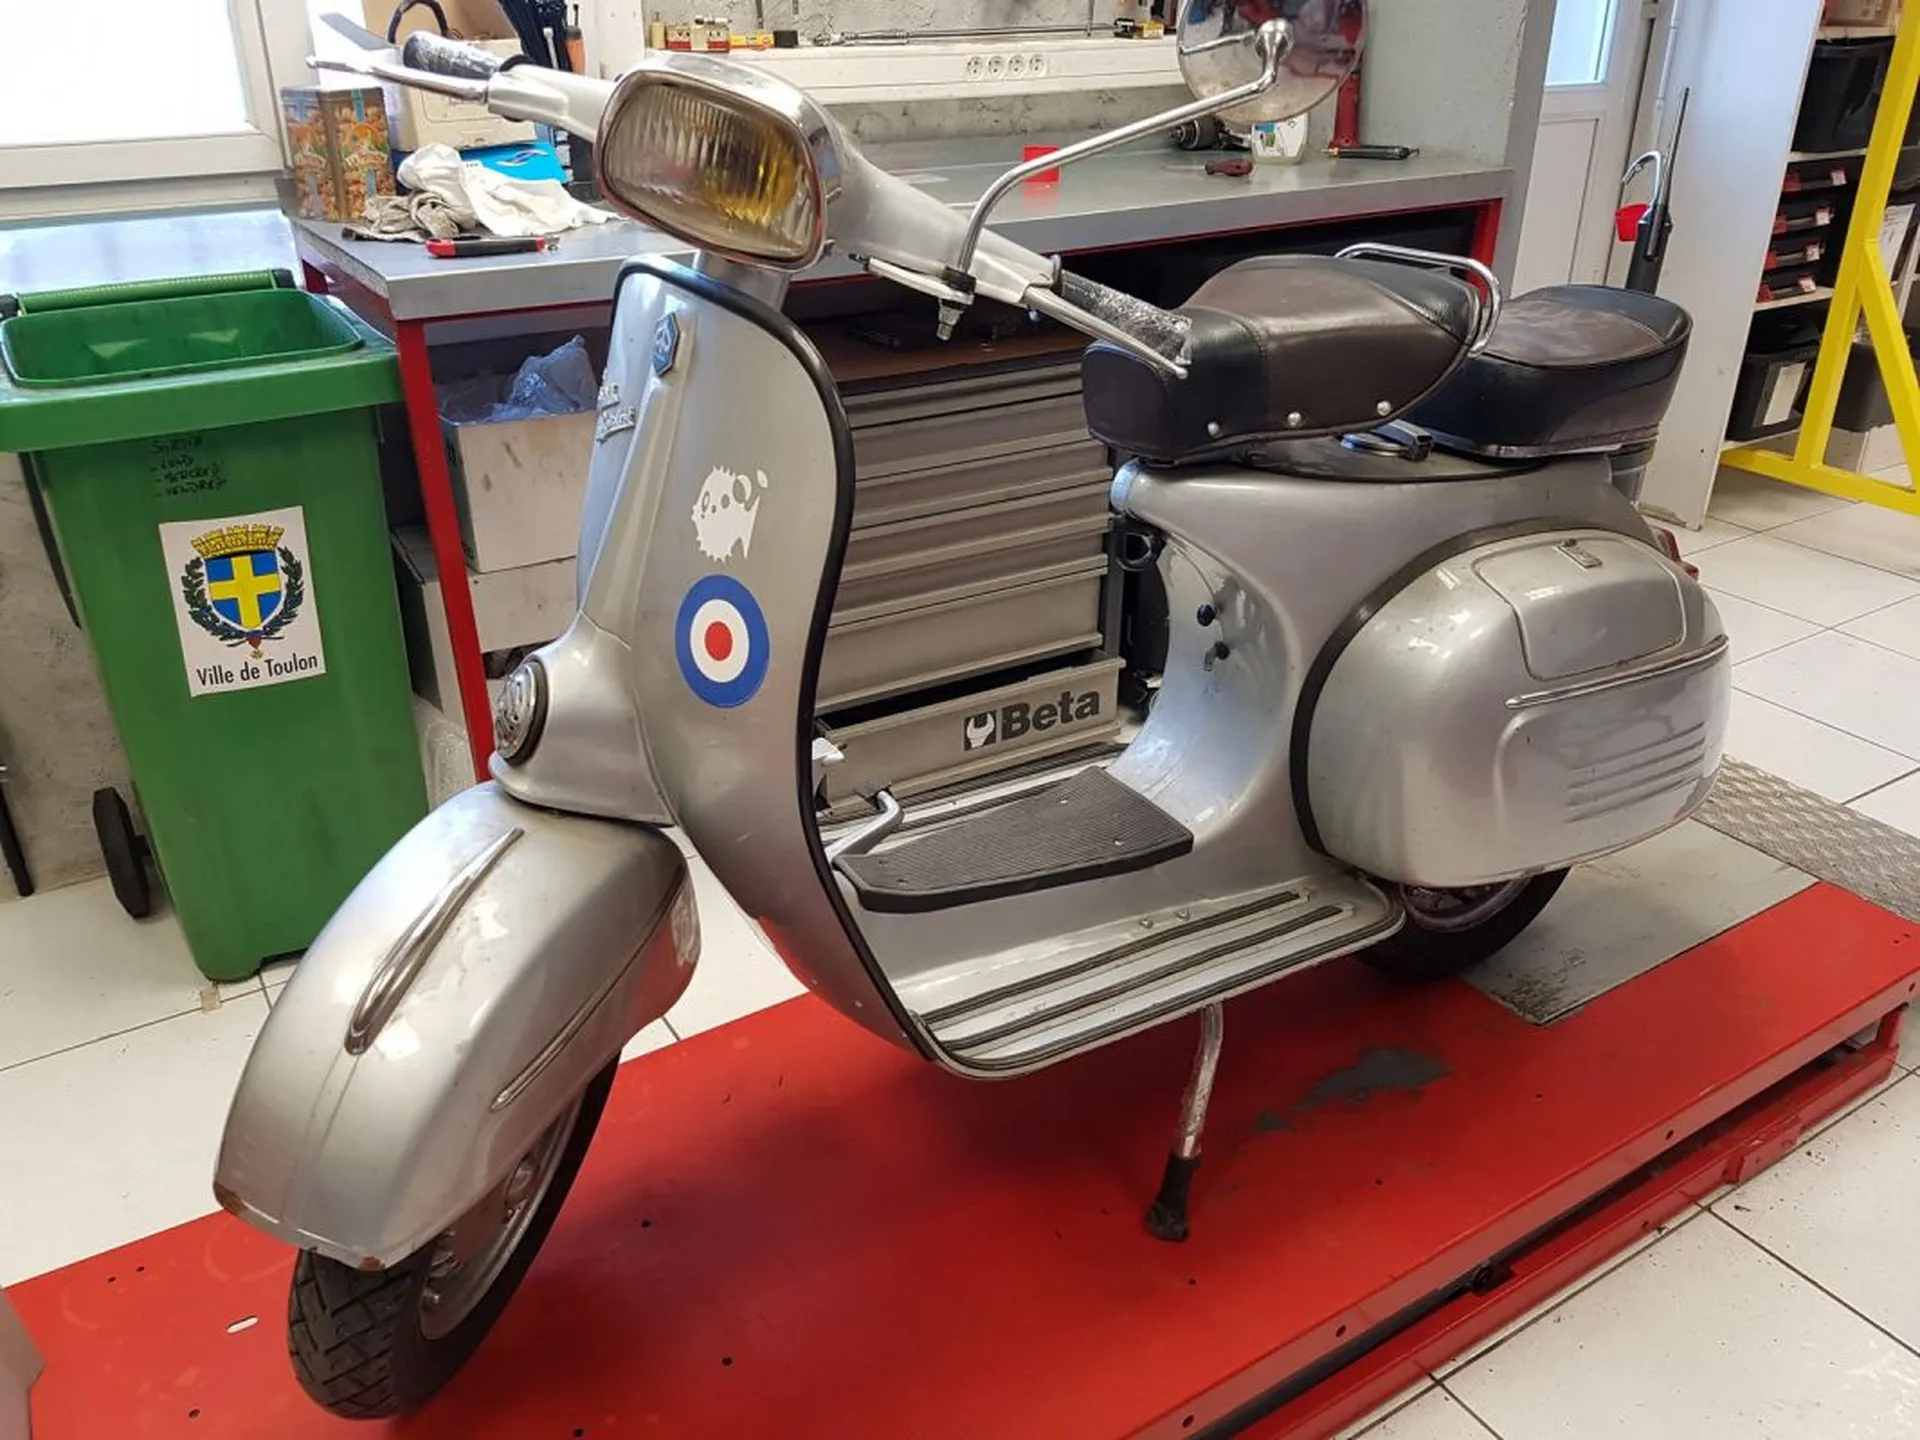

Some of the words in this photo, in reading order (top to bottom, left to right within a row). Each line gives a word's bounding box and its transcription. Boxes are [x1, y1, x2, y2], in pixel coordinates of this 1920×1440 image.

[196, 664, 235, 686] Ville
[240, 661, 260, 681] de
[264, 653, 318, 677] Toulon
[1001, 691, 1100, 740] Beta
